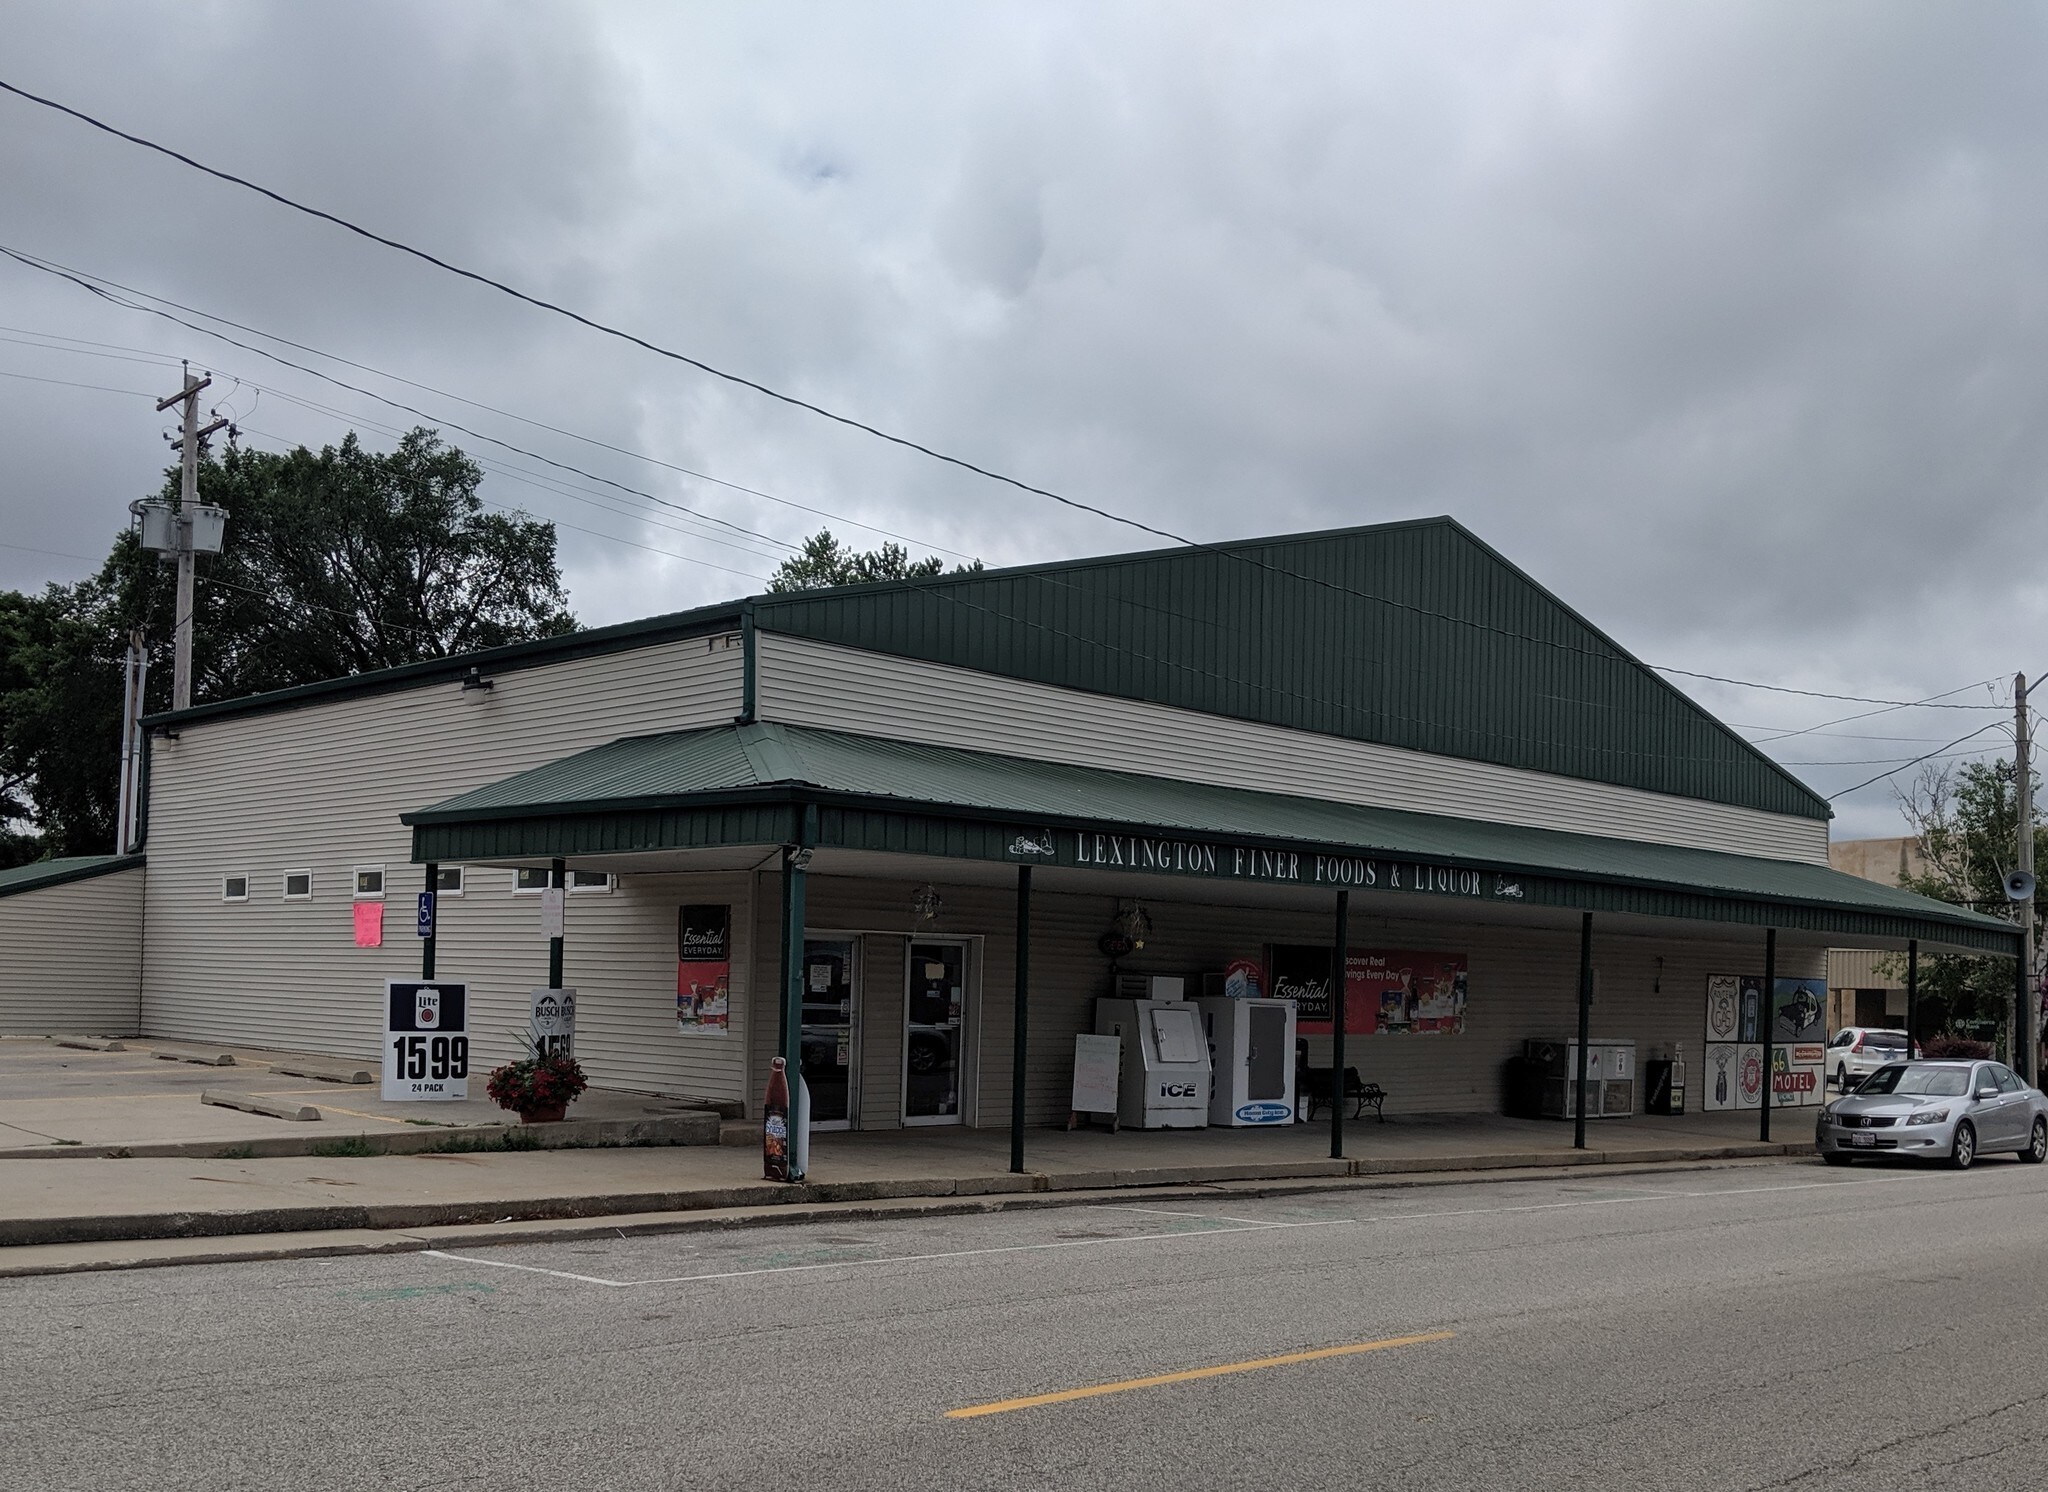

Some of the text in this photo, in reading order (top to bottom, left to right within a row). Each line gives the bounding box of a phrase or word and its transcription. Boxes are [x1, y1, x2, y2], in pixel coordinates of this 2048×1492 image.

[1077, 832, 1480, 895] LEXINGTON FINER FOODS & LIQUOR
[683, 927, 725, 945] Essential
[1345, 956, 1386, 967] scover Real
[1345, 970, 1400, 982] vings Every Day
[1273, 976, 1329, 999] Essential
[417, 996, 438, 1008] Lite
[535, 1006, 560, 1018] BUSCH
[1772, 1049, 1785, 1072] 66
[411, 1083, 444, 1092] 24 PACK
[1160, 1081, 1197, 1098] ICE
[1774, 1074, 1811, 1090] MOTEL
